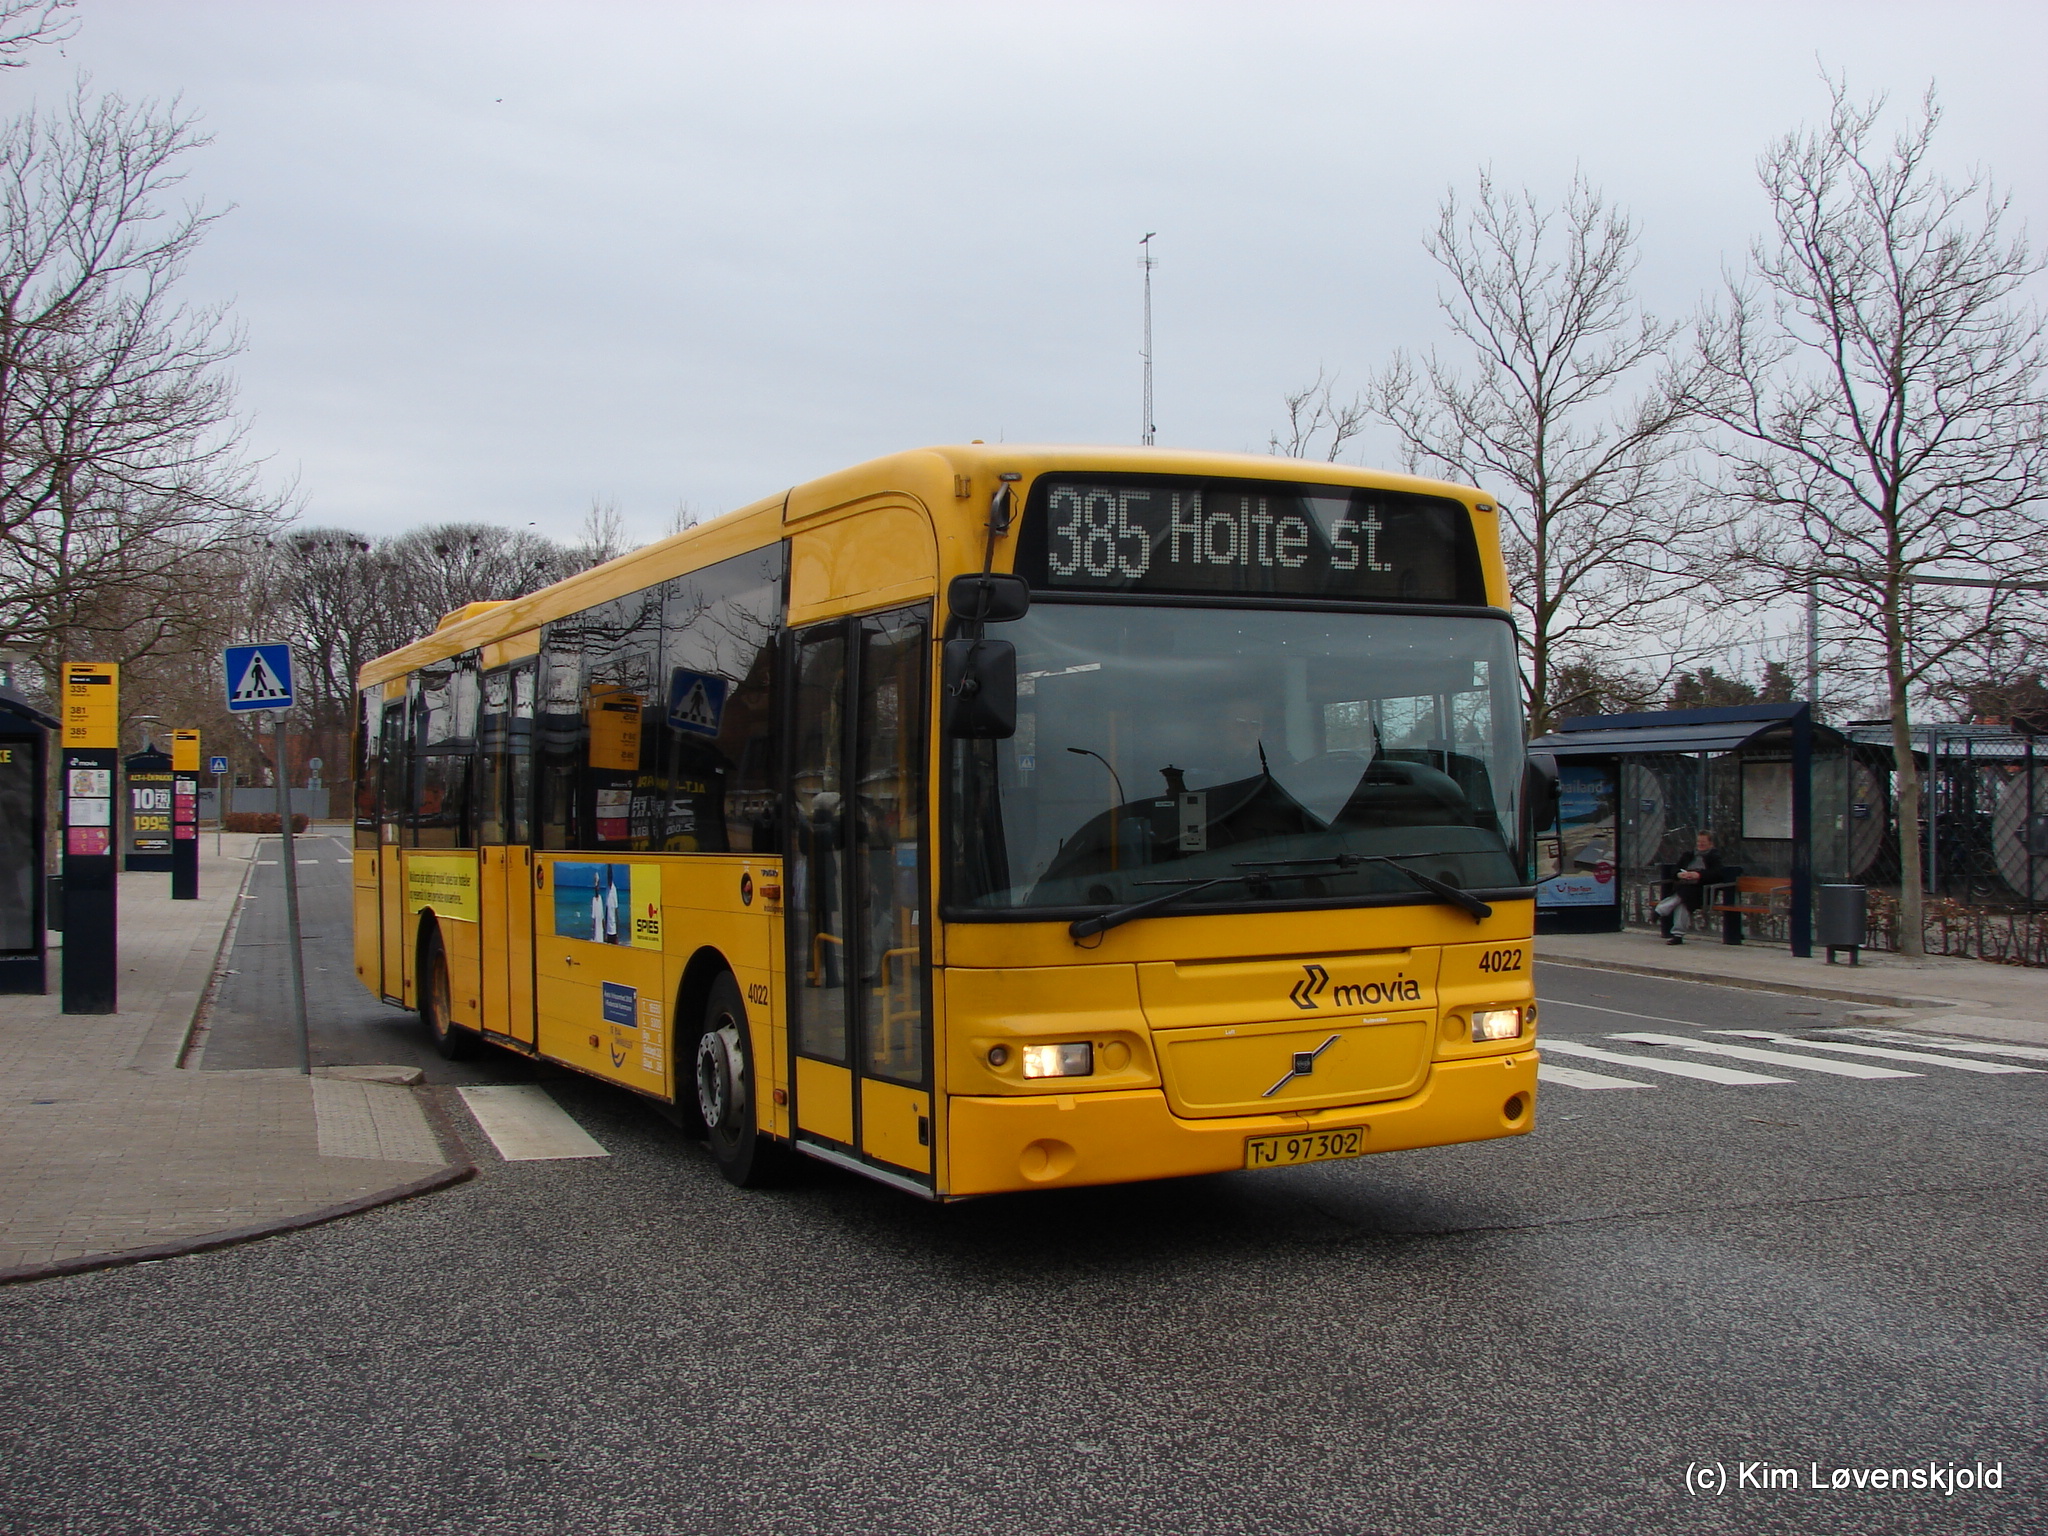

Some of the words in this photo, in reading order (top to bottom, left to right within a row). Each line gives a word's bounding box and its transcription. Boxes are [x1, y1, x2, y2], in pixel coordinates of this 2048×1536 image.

[1048, 486, 1151, 579] 385
[1170, 490, 1309, 569] Holte
[1330, 505, 1392, 572] st.
[70, 685, 87, 693] 335
[70, 706, 86, 714] 381
[70, 727, 87, 735] 385
[1558, 778, 1603, 793] hailand
[132, 788, 155, 809] 10
[155, 793, 171, 804] FRI
[134, 816, 160, 831] 199
[637, 918, 659, 934] SPIES
[1478, 949, 1521, 974] 4022
[748, 982, 768, 1006] 4022
[1334, 972, 1421, 1007] movia
[1251, 1141, 1279, 1164] TJ
[1286, 1132, 1359, 1161] 97302
